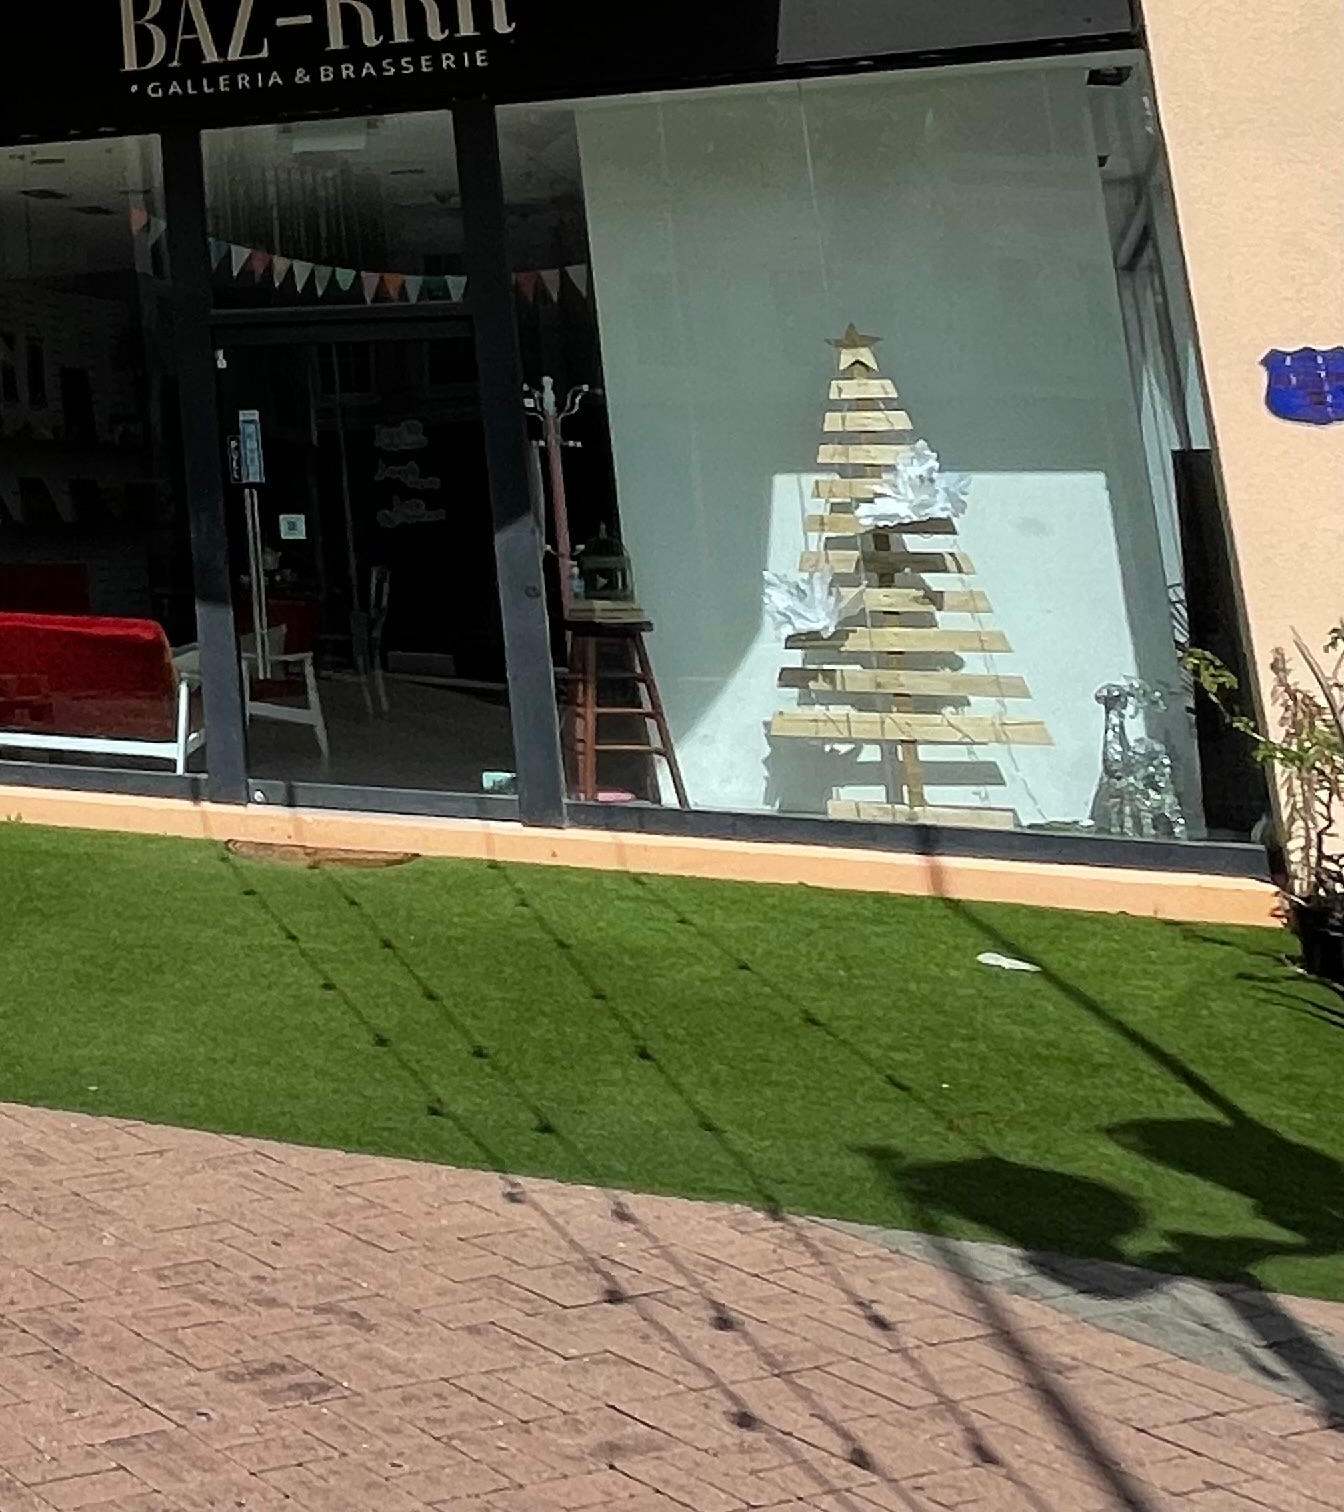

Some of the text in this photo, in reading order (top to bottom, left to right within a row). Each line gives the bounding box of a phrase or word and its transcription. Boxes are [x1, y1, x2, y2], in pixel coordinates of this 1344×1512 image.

[146, 49, 490, 98] GALLERIA & BRASSERIE
